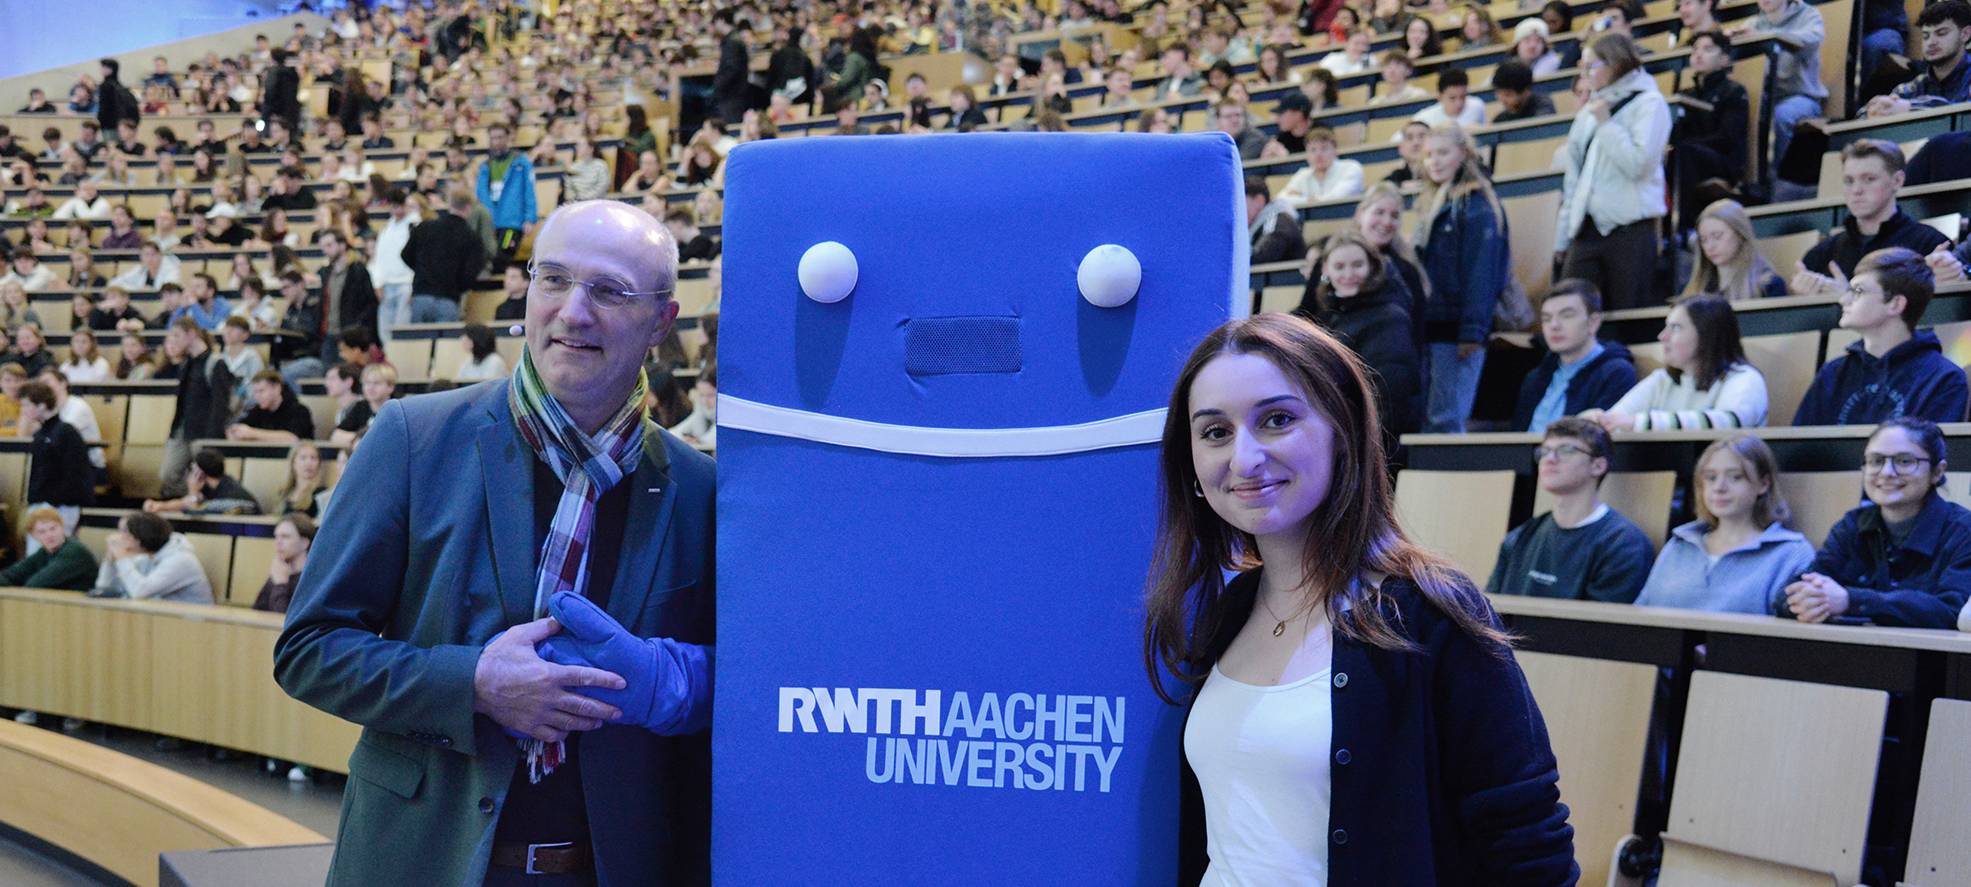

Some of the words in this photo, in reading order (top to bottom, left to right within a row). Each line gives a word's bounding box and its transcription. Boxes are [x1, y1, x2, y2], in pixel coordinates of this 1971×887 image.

[778, 687, 941, 736] RWTH
[943, 691, 1125, 743] AACHEN
[866, 737, 1124, 793] UNIVERSITY
